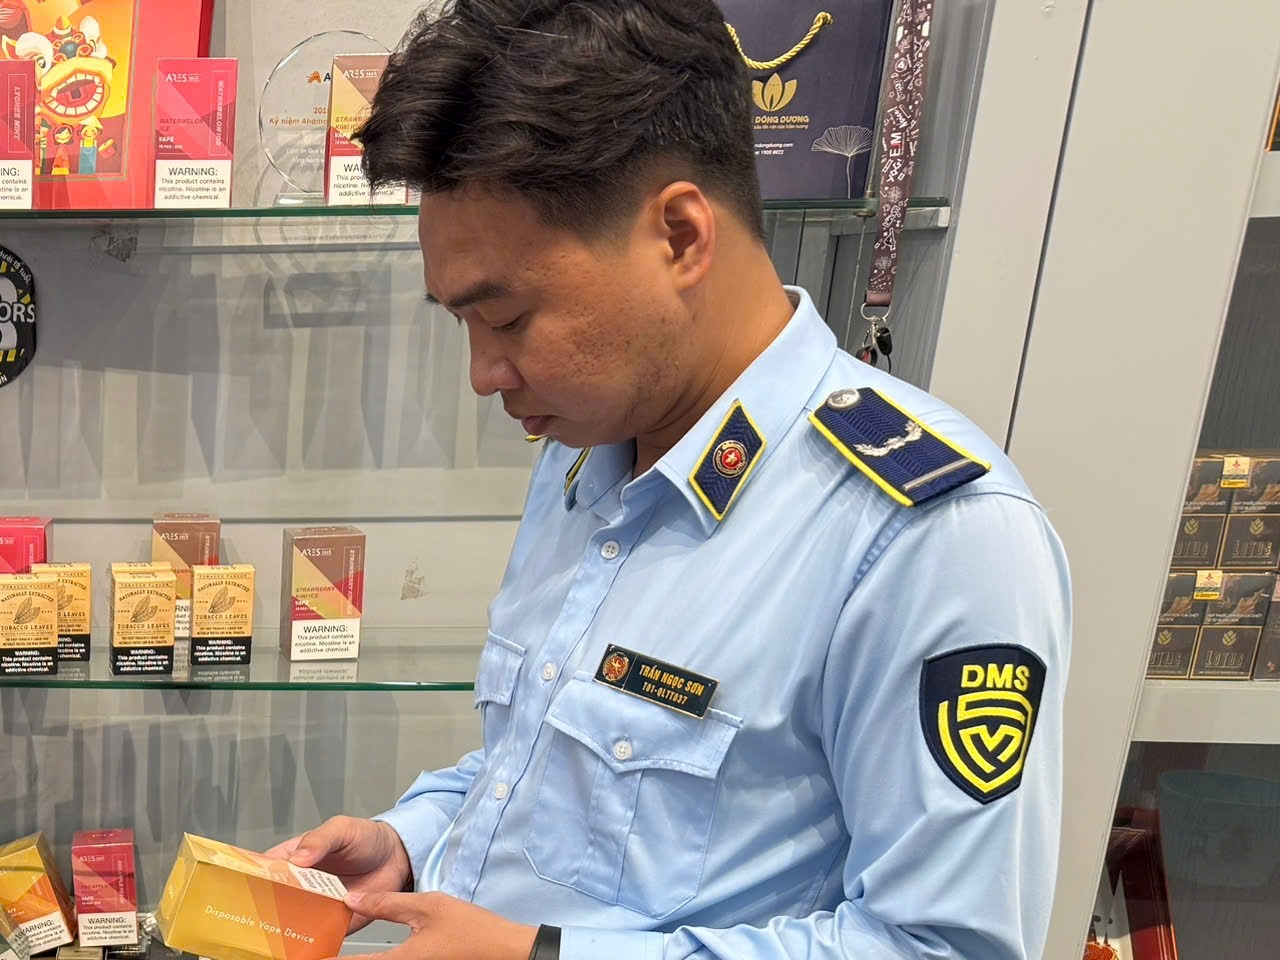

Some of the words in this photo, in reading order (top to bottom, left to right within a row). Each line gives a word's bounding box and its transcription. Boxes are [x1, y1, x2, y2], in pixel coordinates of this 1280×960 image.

[168, 168, 218, 176] WARNING:
[301, 548, 321, 556] ARES
[303, 624, 348, 633] WARNING:
[961, 663, 1030, 691] DMS
[205, 905, 255, 927] Disposable
[259, 922, 281, 934] Vape
[284, 929, 315, 943] Device
